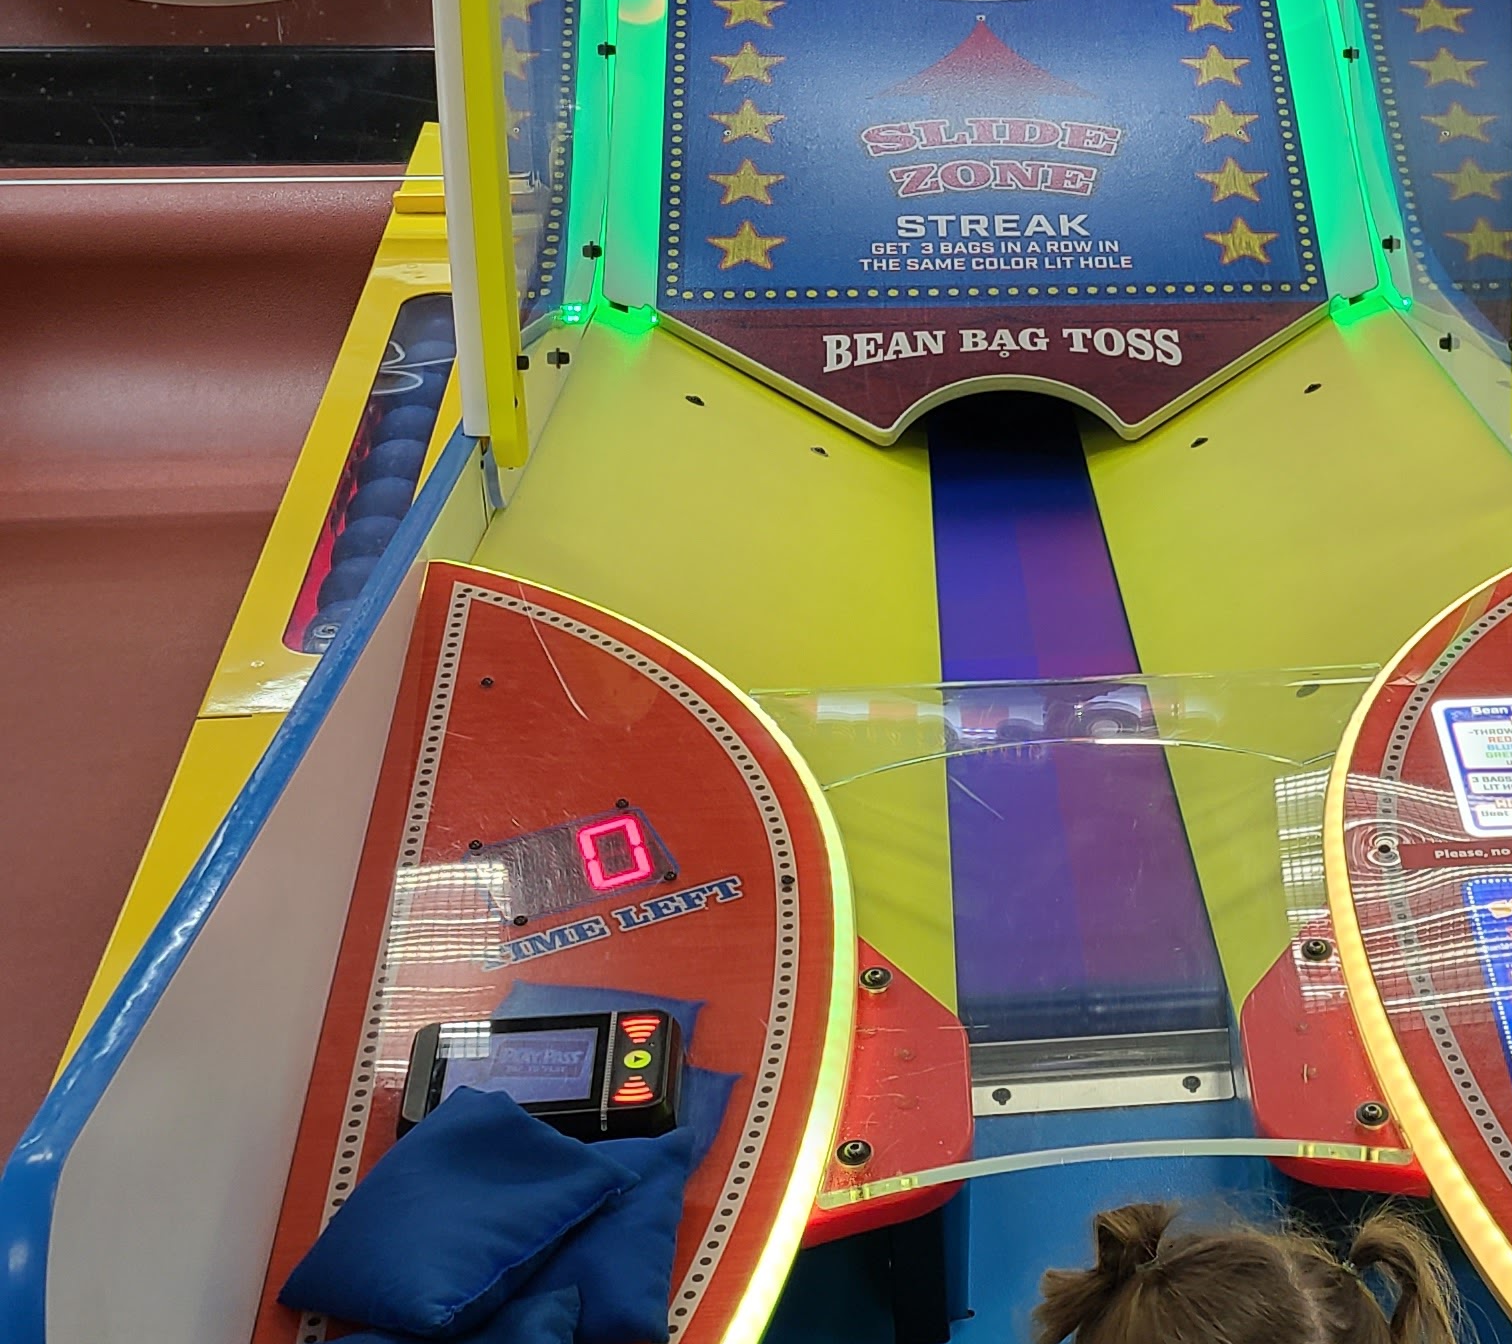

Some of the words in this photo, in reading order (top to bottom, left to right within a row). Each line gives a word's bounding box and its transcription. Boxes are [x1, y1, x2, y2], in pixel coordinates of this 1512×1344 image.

[859, 116, 1123, 157] SLIDE
[888, 157, 1099, 200] ZONE
[896, 213, 1092, 239] STREAK
[871, 241, 912, 256] GET
[920, 241, 935, 255] 3
[939, 240, 995, 255] BAGS
[1000, 240, 1022, 254] IN
[1026, 240, 1042, 254] A
[1046, 240, 1093, 254] ROW
[1098, 239, 1120, 253] IN
[859, 257, 902, 272] THE
[906, 257, 966, 272] SAME
[971, 256, 1039, 271] COLOR
[1044, 256, 1076, 270] LIT
[1079, 255, 1134, 269] HOLE
[821, 327, 947, 374] BEAN
[958, 326, 1051, 356] BAG
[1061, 327, 1184, 368] TOSS
[1470, 706, 1509, 716] Bean
[1487, 734, 1512, 745] RED
[576, 814, 655, 892] 0
[1434, 848, 1489, 860] Please,
[1490, 846, 1511, 857] no
[611, 875, 744, 932] LEFT
